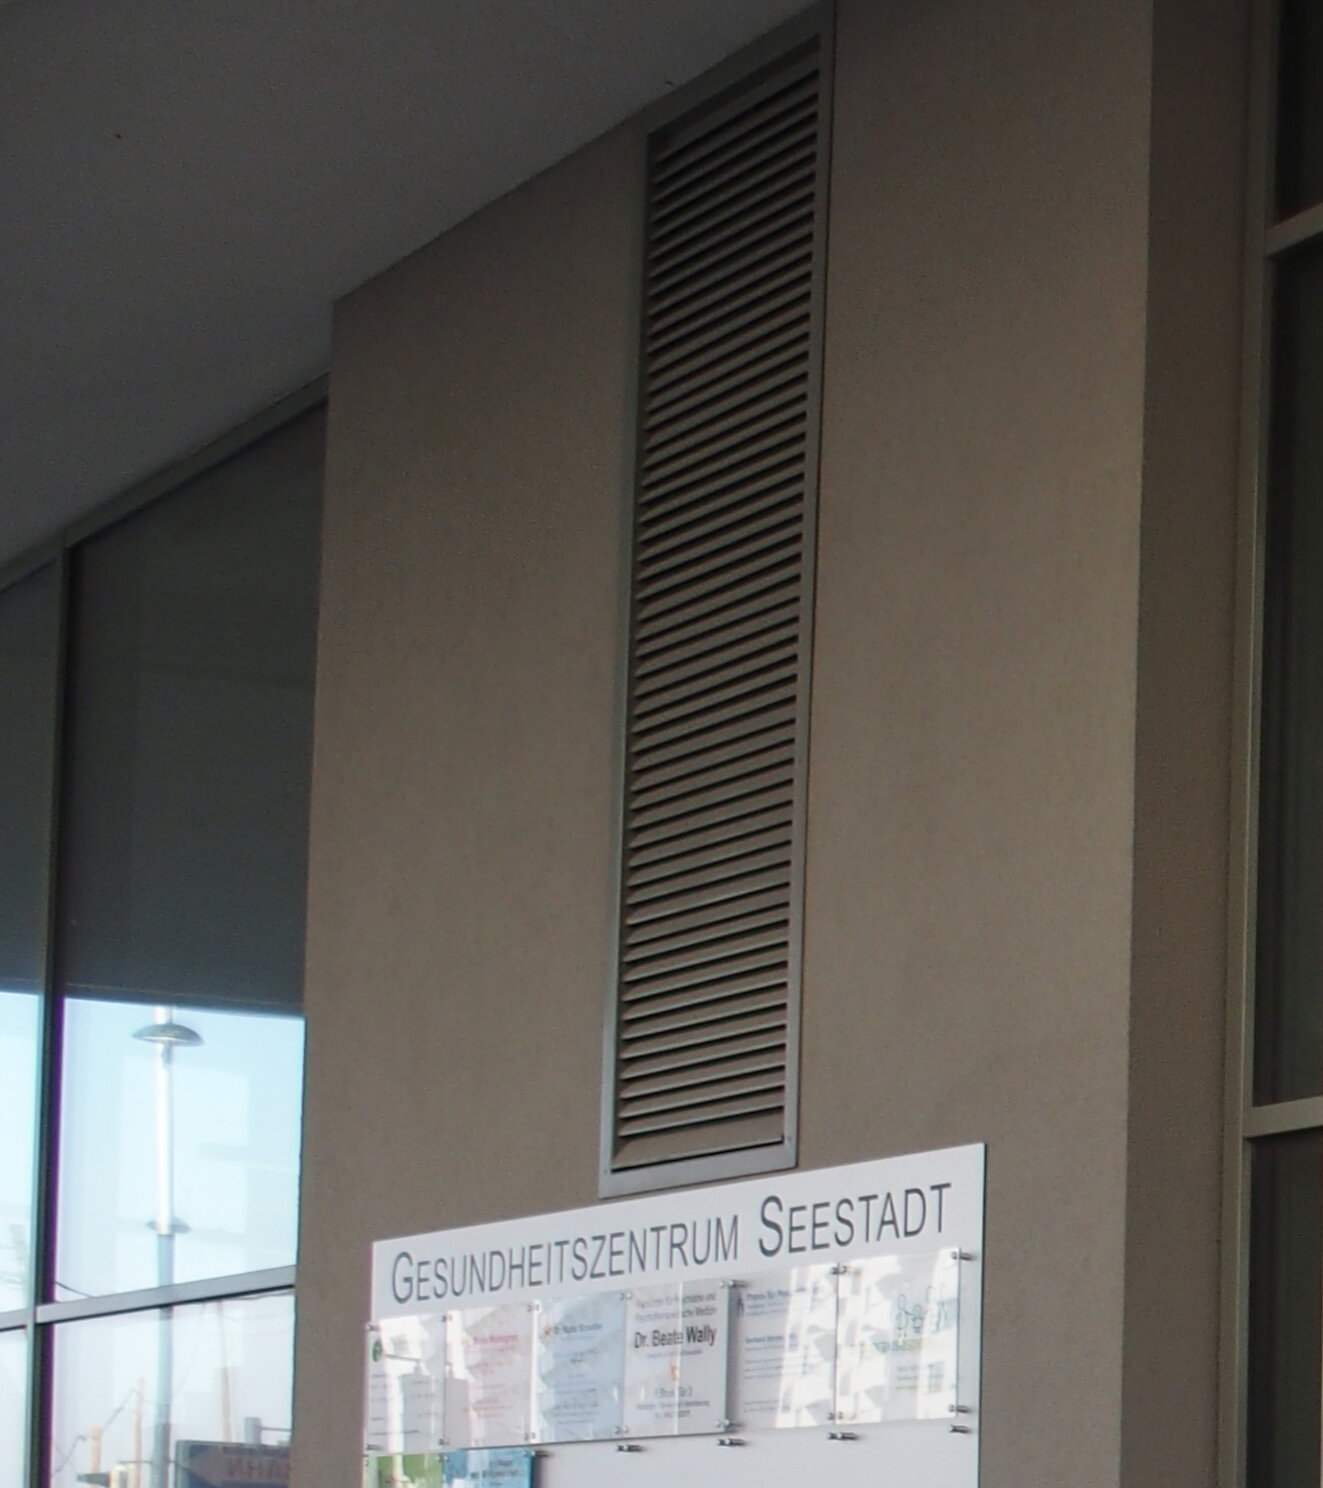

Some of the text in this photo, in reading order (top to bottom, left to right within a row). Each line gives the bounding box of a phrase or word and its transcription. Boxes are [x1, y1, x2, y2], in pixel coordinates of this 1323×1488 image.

[391, 1182, 953, 1304] GESUNDHEITSZENTRUM SEESTADT
[634, 1324, 717, 1349] Dr. Beate Wally
